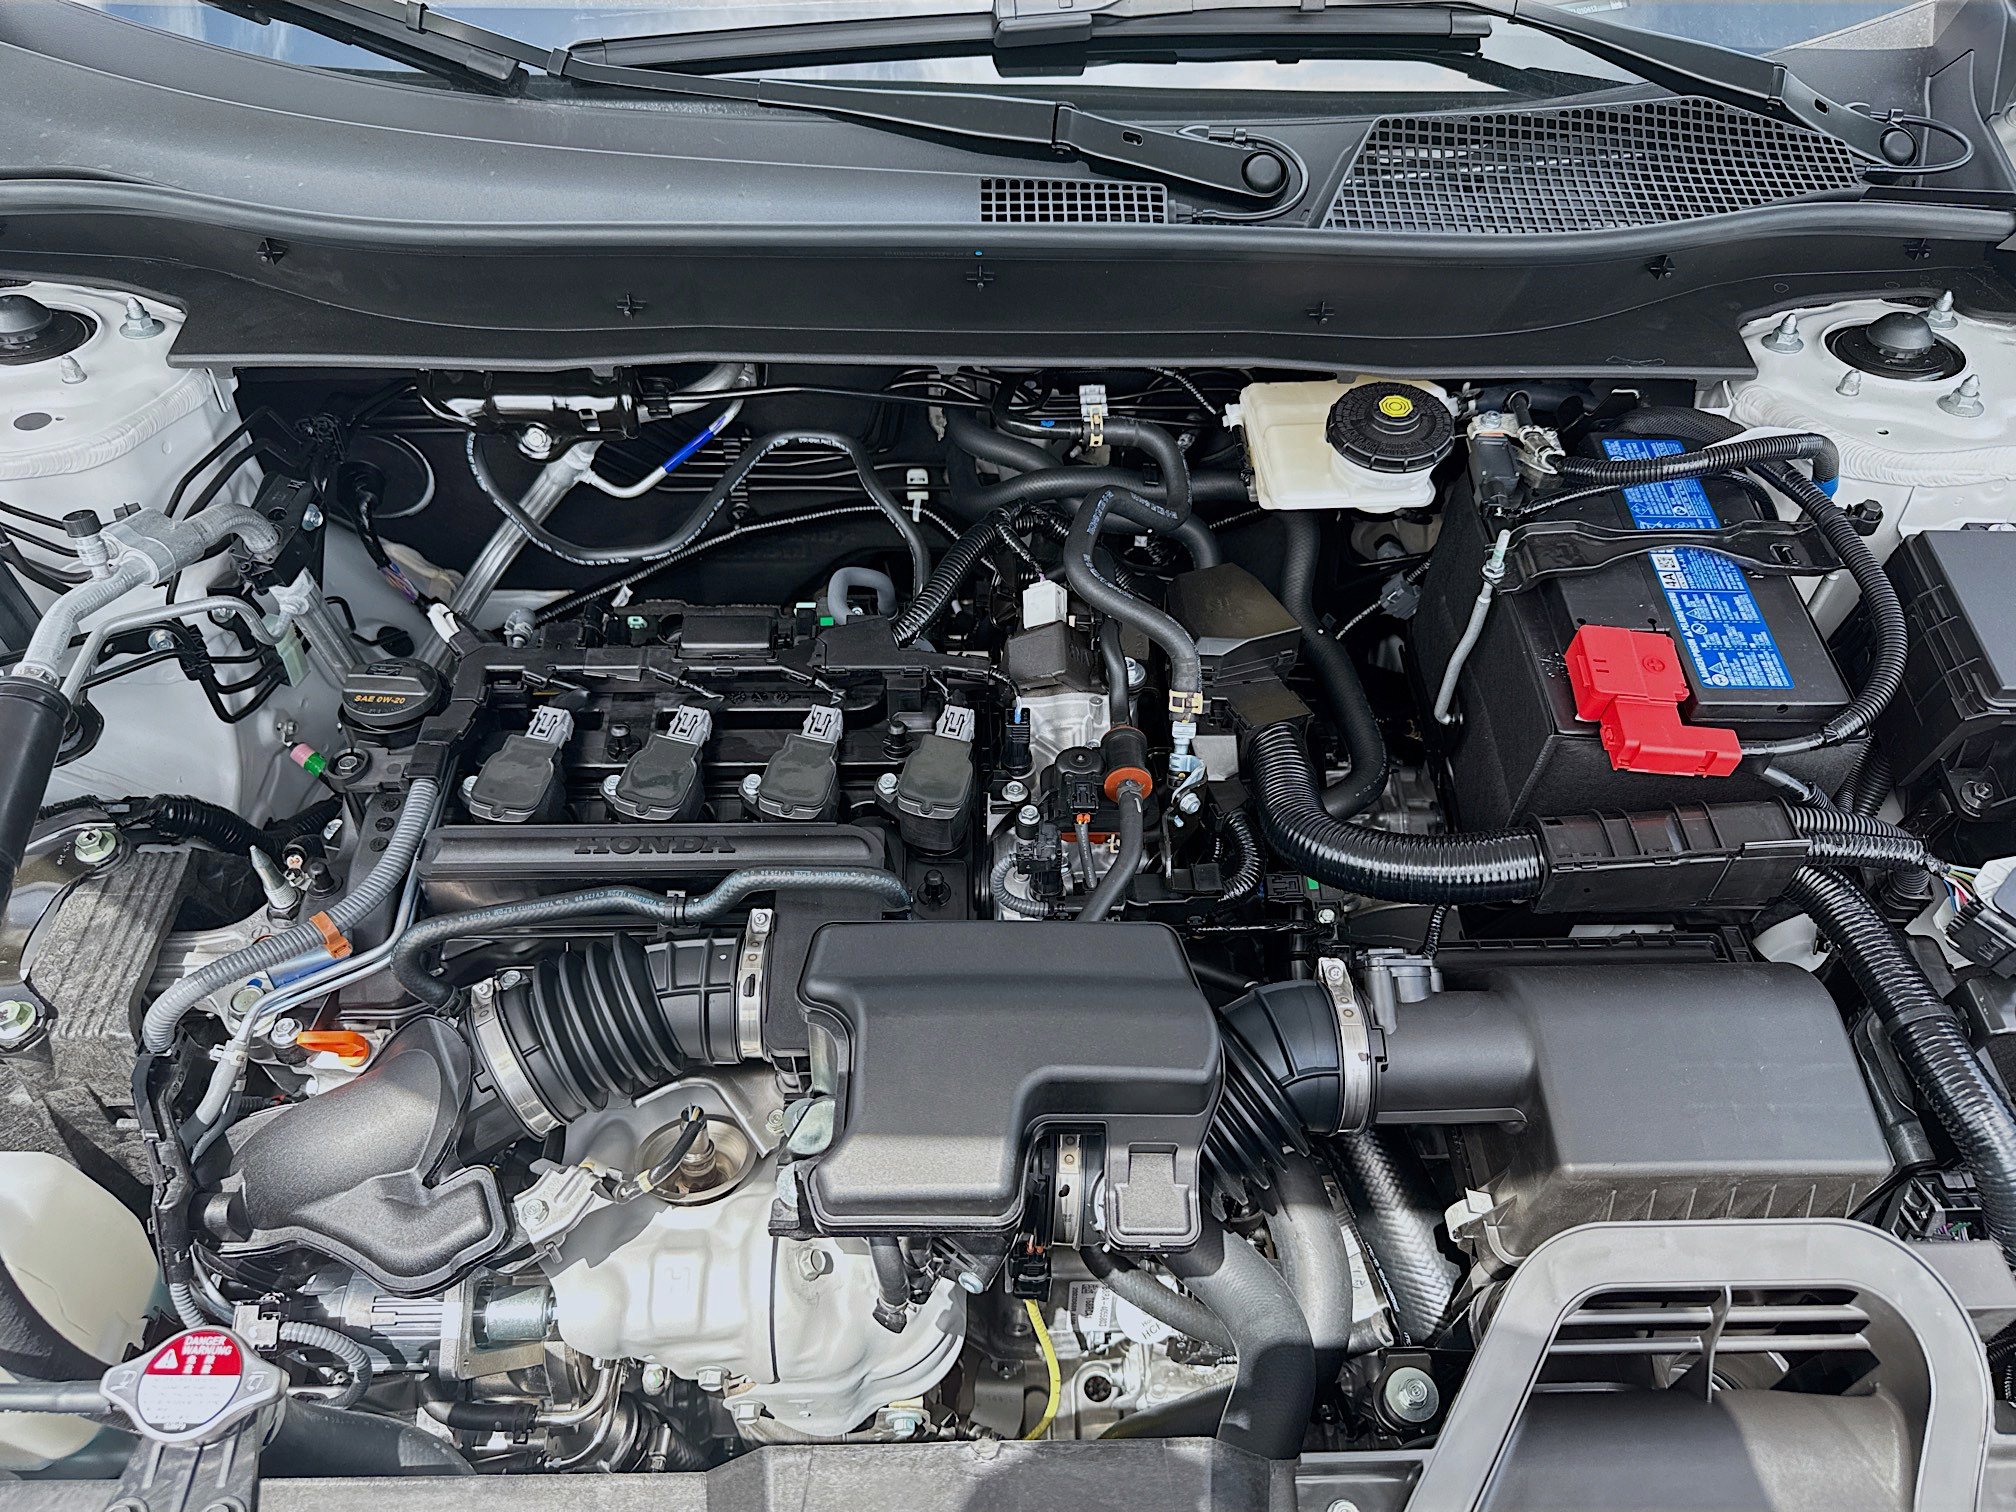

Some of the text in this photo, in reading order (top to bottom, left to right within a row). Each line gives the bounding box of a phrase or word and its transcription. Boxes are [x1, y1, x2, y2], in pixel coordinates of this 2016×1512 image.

[1662, 573, 1676, 587] 4A
[354, 694, 406, 704] SAE 0W-20
[574, 836, 736, 855] HONDA
[185, 1335, 227, 1346] DANGER
[181, 1345, 234, 1356] WARNUNG
